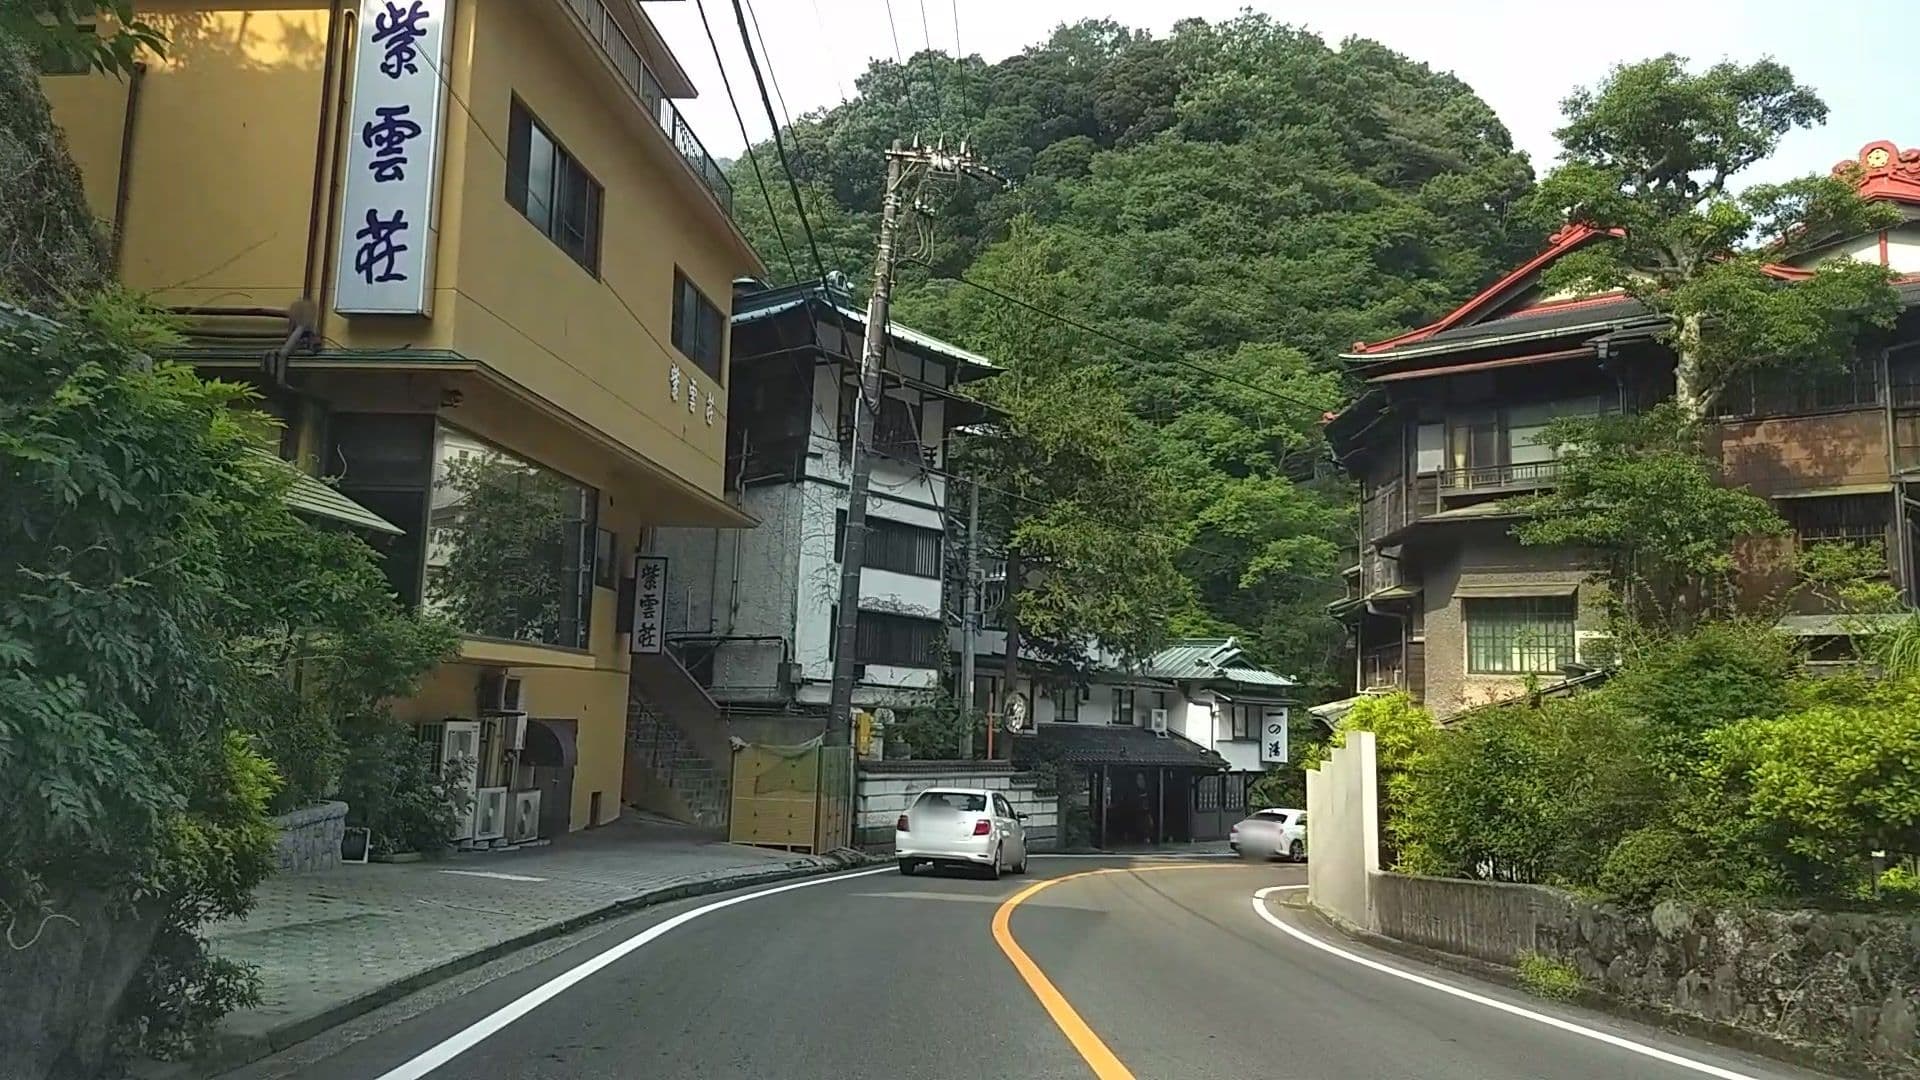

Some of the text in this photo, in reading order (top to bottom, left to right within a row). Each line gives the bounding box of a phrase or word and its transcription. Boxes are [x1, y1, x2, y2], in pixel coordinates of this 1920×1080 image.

[355, 0, 430, 284] 紫雲荘
[638, 564, 660, 648] 紫雲荘
[1266, 711, 1283, 758] 一の湯
